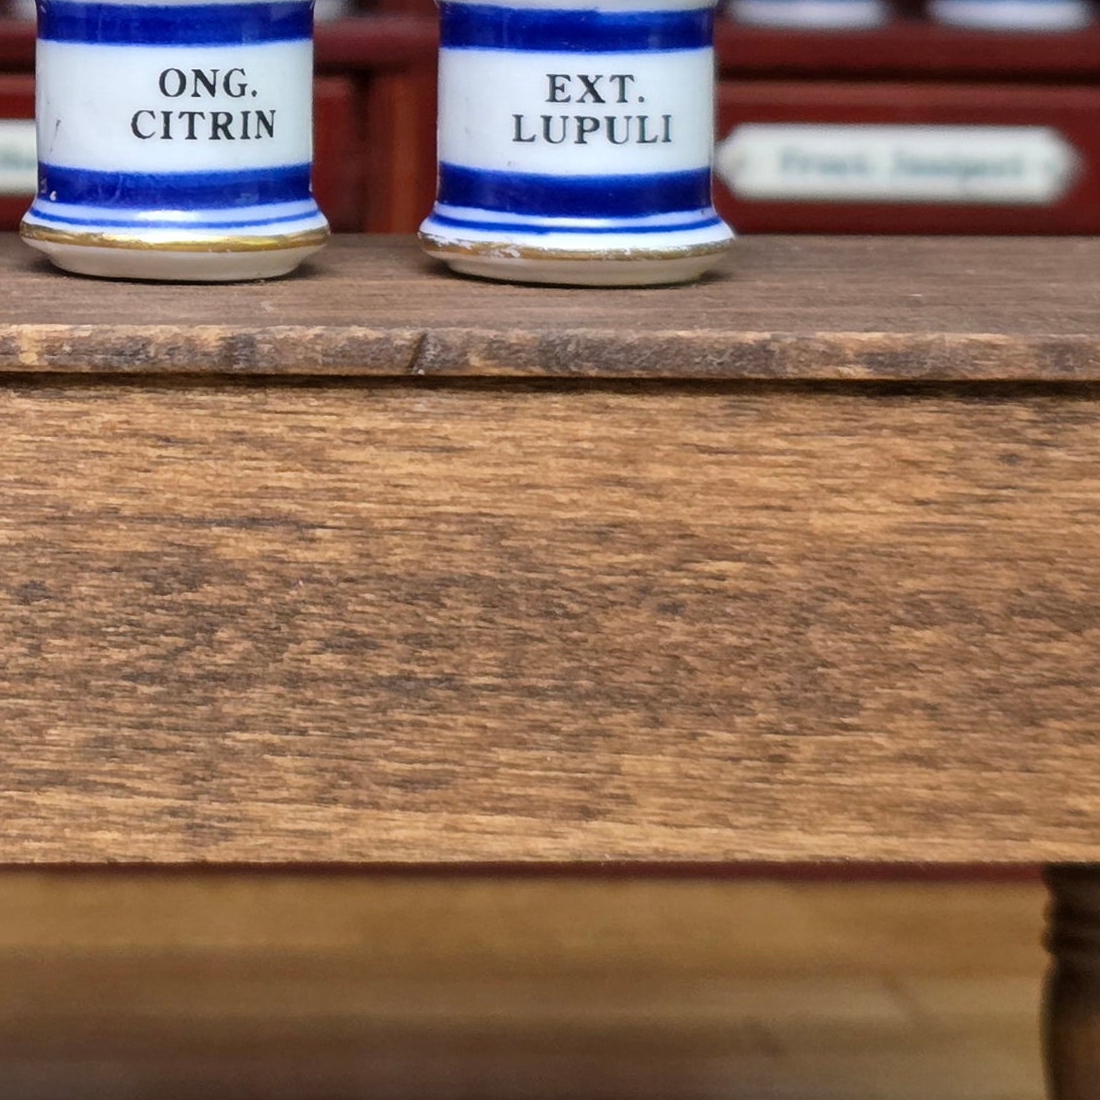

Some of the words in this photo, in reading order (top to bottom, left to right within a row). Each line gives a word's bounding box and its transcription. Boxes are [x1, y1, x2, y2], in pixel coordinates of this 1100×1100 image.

[158, 67, 258, 98] ONG.
[546, 74, 645, 104] EXT.
[130, 109, 276, 141] CITRIN
[512, 114, 673, 145] LUPULI
